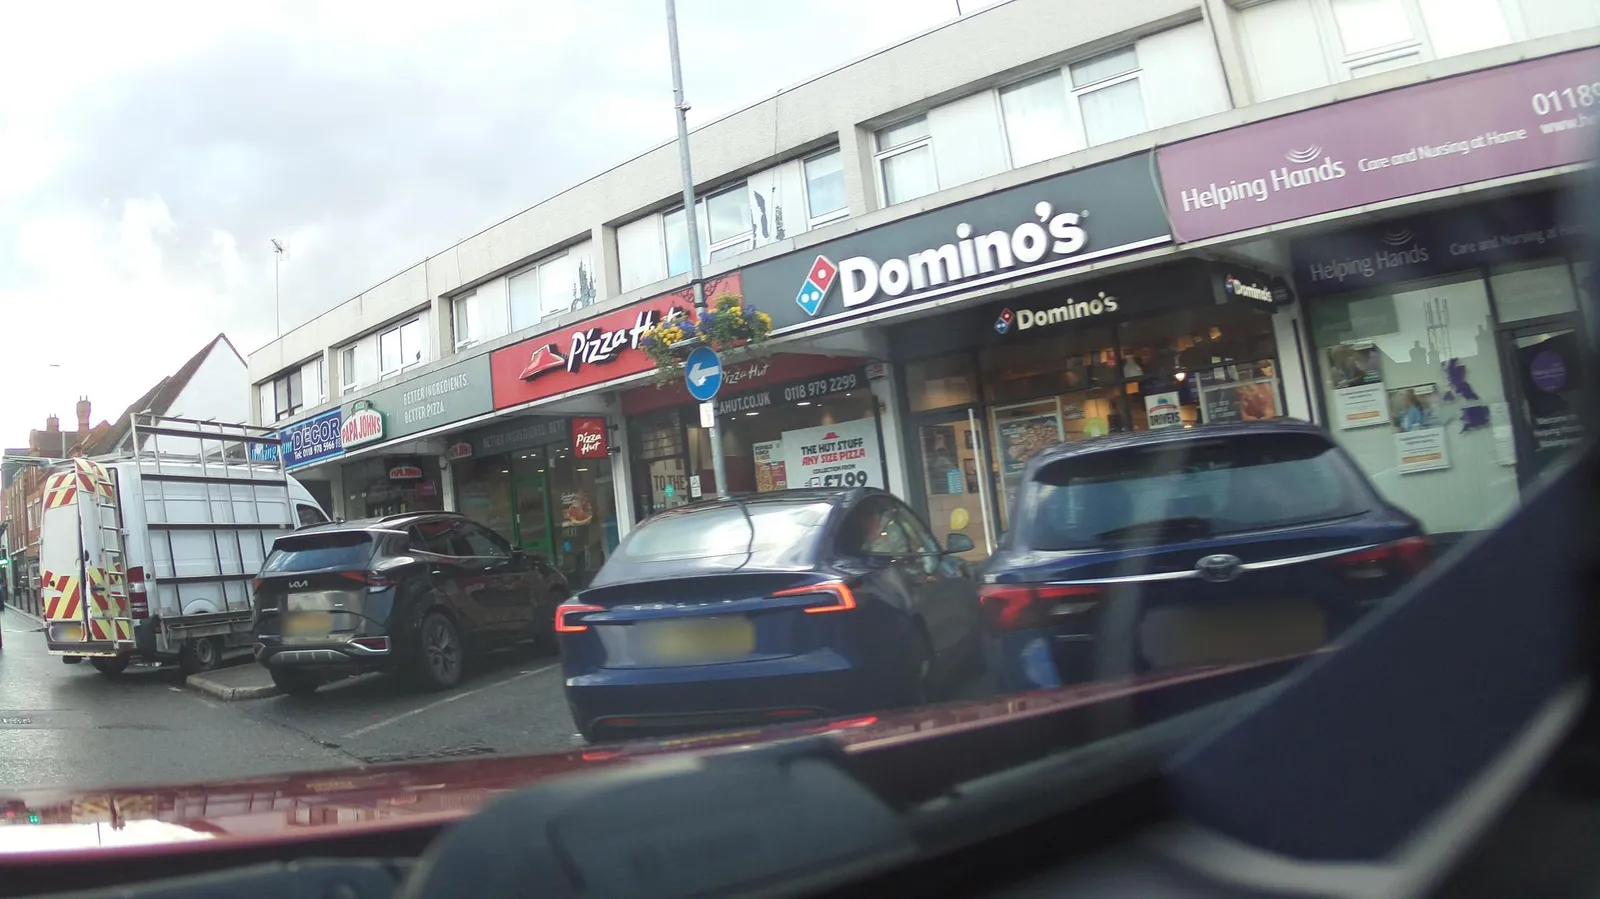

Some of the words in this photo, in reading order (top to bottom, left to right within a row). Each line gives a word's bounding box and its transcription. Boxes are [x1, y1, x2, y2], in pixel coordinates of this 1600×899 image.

[1357, 157, 1391, 172] Care
[1391, 147, 1418, 165] and
[1417, 140, 1470, 160] Nursing
[1470, 135, 1487, 149] at
[1486, 128, 1528, 146] Home
[1181, 177, 1268, 212] Helping
[1269, 156, 1346, 192] Hands
[838, 200, 1088, 308] Domino's
[1309, 256, 1375, 282] Helping
[1376, 245, 1429, 270] Hands
[1016, 291, 1118, 331] Domino's
[567, 328, 627, 373] Pizza
[627, 307, 682, 349] Ht
[748, 363, 770, 380] Hut
[403, 387, 425, 406] BETTER
[719, 391, 771, 415] AHUT.CO.UK
[784, 386, 806, 401] 0118
[809, 380, 827, 396] 979
[830, 374, 856, 392] 2299
[404, 405, 426, 424] BETTER
[1149, 412, 1180, 426] DRIVERS
[342, 418, 358, 443] PAPA
[576, 432, 602, 447] Pizza
[580, 441, 601, 455] Hut
[801, 444, 817, 456] THE
[818, 441, 836, 453] HUT
[837, 437, 863, 451] STUFF
[802, 455, 819, 466] ANY
[821, 452, 838, 463] SIZE
[839, 448, 866, 461] PIZZA
